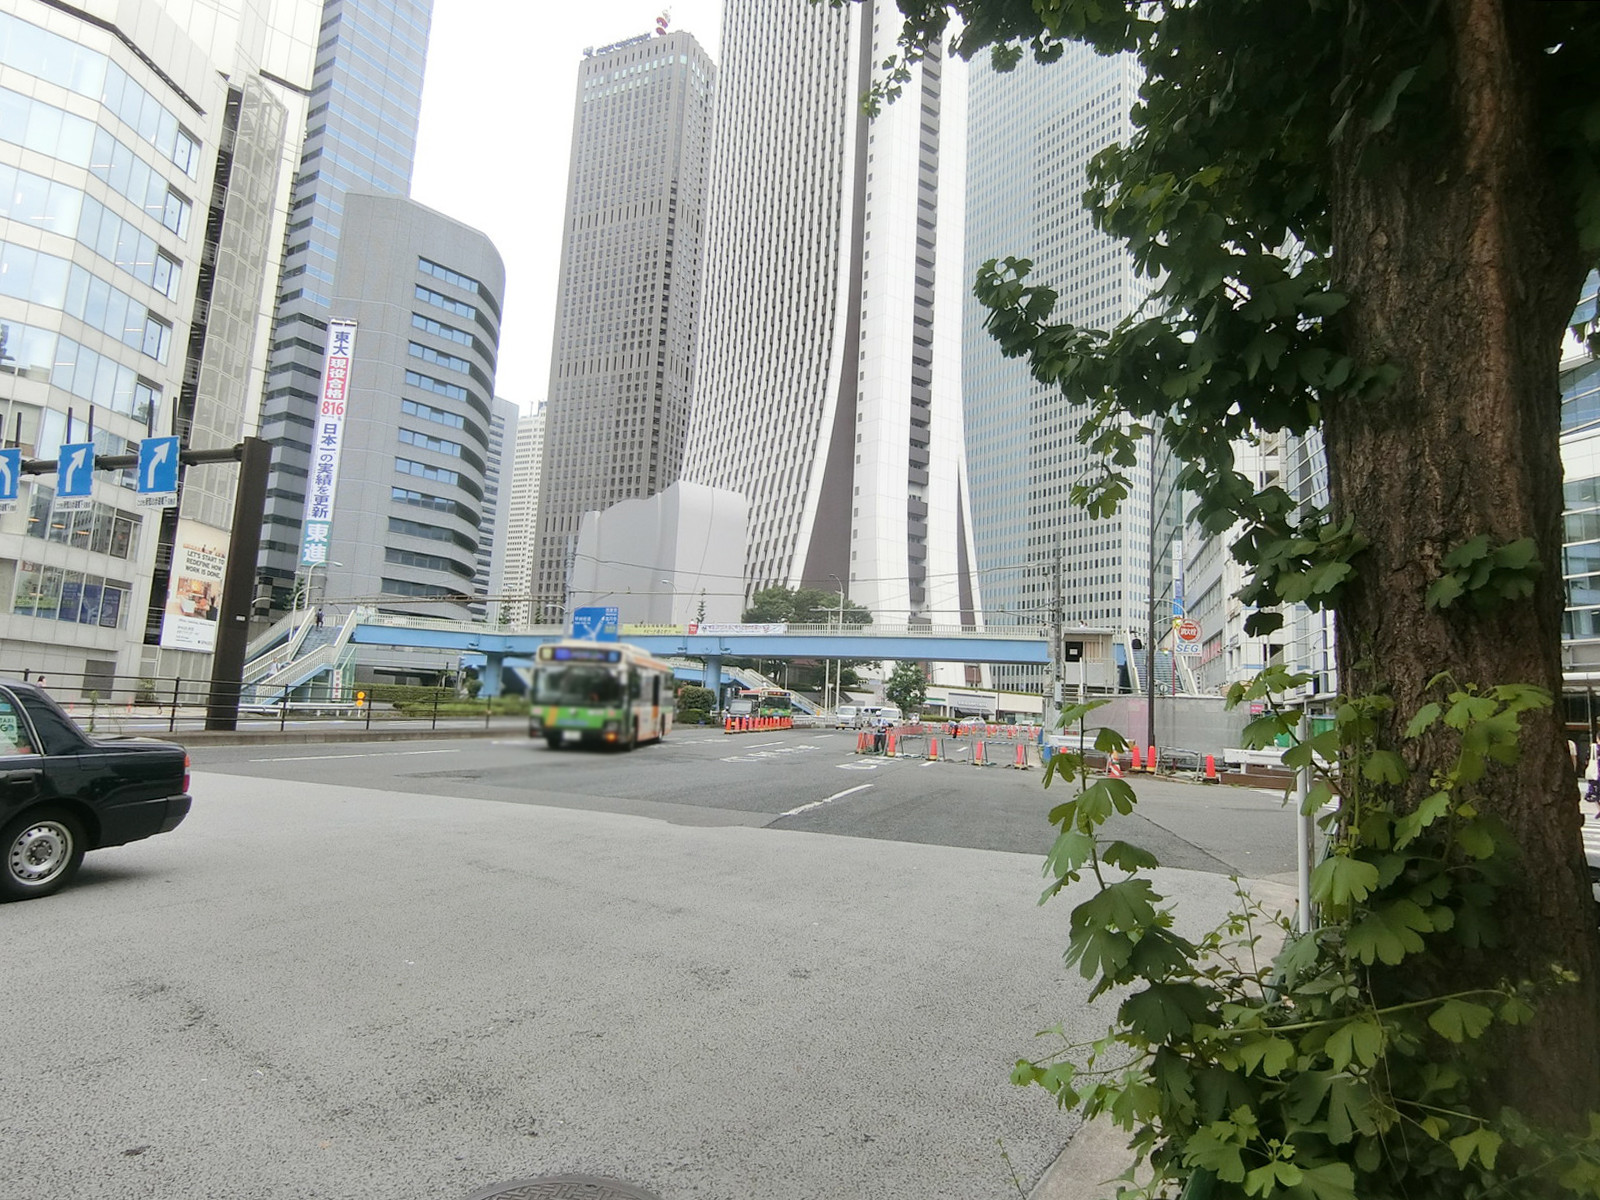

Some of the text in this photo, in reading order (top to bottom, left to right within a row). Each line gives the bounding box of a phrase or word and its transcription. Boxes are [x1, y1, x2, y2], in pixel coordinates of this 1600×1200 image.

[333, 331, 351, 356] 東大
[326, 358, 347, 399] 現役合格
[321, 401, 344, 415] 816
[311, 423, 337, 519] 日本一の実績を更新
[302, 523, 329, 562] 東進
[187, 550, 201, 559] LET'S
[202, 554, 217, 563] START
[185, 565, 200, 573] WORK
[186, 557, 222, 572] REDEFINE HOW
[1180, 627, 1197, 636] 消火栓
[1176, 644, 1199, 653] SEG
